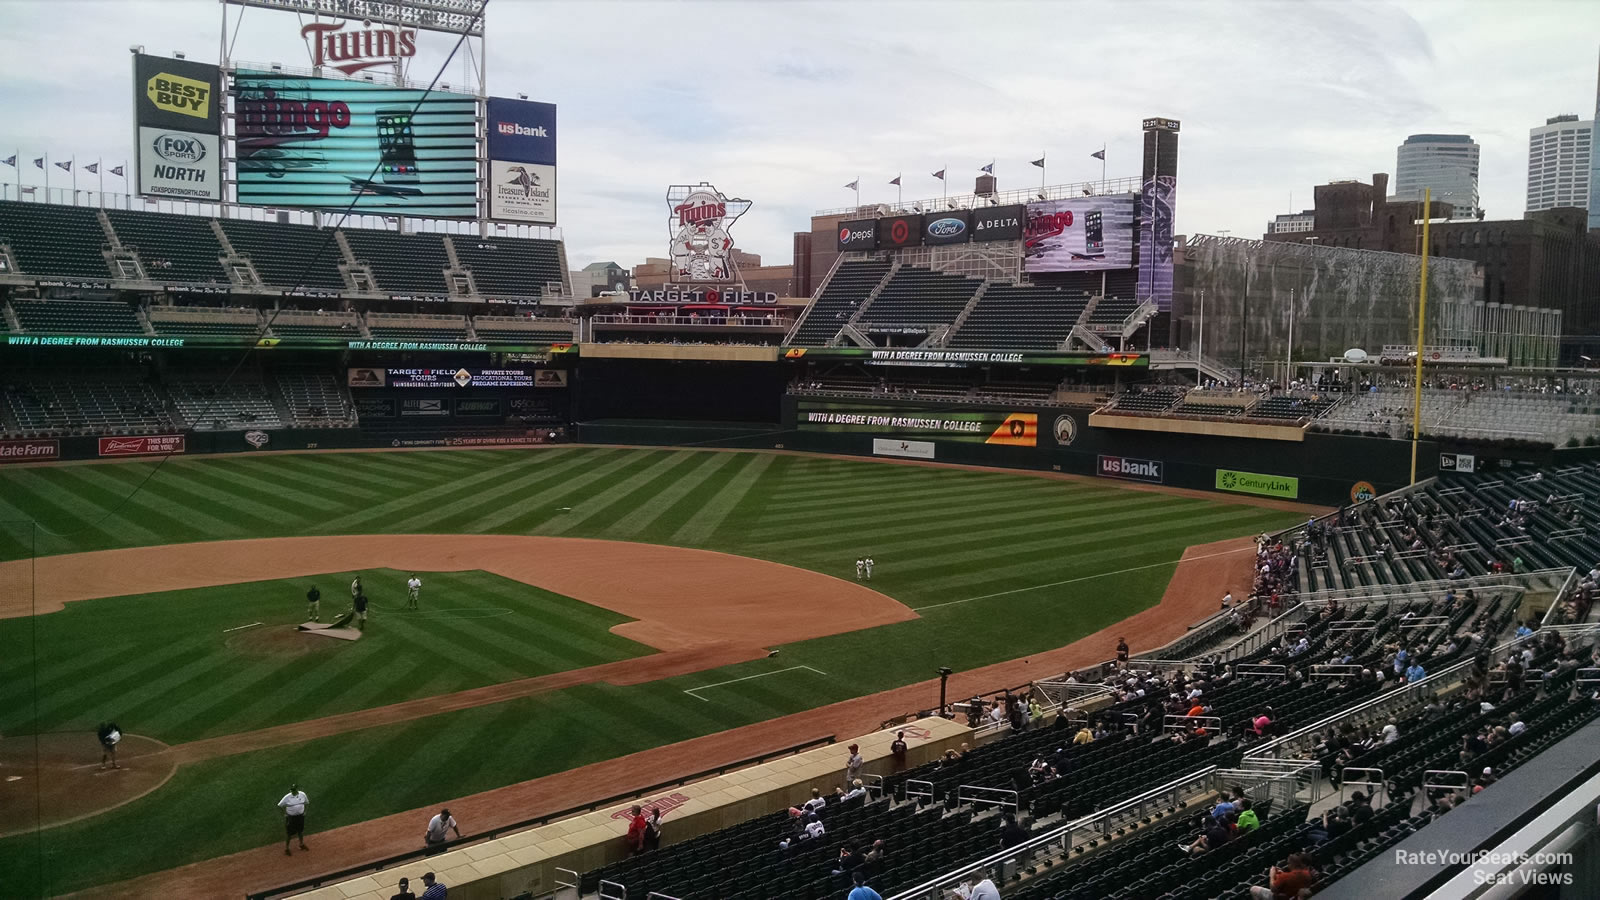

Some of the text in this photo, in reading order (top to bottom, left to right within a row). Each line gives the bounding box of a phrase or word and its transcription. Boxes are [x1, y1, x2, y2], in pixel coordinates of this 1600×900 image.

[301, 18, 417, 75] Twins
[156, 78, 208, 100] BEST
[157, 92, 203, 111] BUY
[164, 138, 195, 154] FOX
[164, 151, 196, 160] SPORTS
[154, 164, 206, 182] NORTH
[151, 186, 210, 198] FOXSPORTSNORTH.COM
[497, 185, 550, 198] Treasure Island
[674, 201, 726, 227] Twins
[934, 223, 958, 234] Ford
[986, 218, 1018, 229] DELTA
[851, 228, 874, 242] pepsi
[630, 291, 778, 303] TARGET FIELD
[8, 337, 30, 345] WITH
[945, 353, 988, 361] RASMUSSEN
[990, 354, 1023, 362] COLLEGE
[457, 401, 496, 411] SUBWAY
[808, 413, 981, 432] WITH A DEGREE FROM RASMUSSEN COLLEGE
[1103, 459, 1159, 476] usbank
[1240, 478, 1290, 492] CenturyLink
